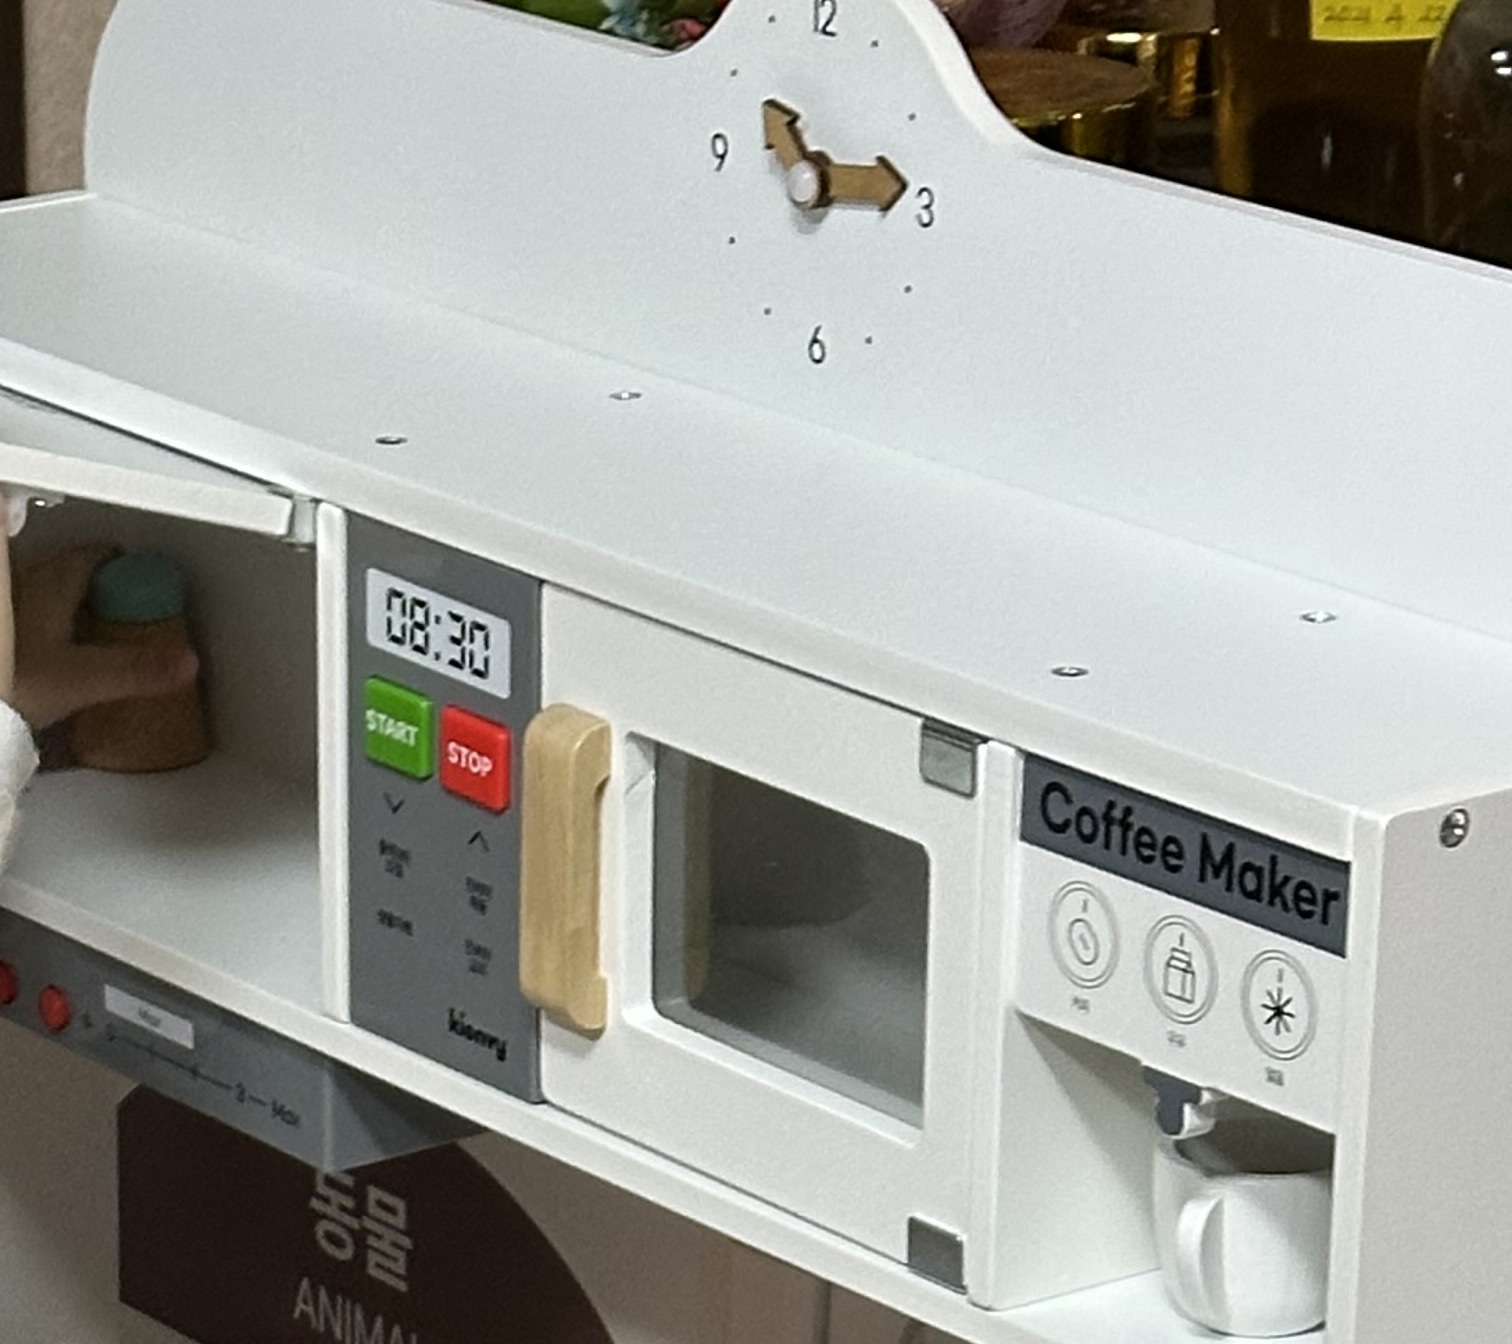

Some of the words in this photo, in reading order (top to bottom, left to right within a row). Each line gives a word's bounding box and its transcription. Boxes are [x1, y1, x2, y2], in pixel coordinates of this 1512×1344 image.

[813, 0, 837, 37] 12
[710, 132, 729, 172] 9
[916, 186, 935, 228] 3
[807, 324, 827, 365] 6
[386, 586, 490, 681] 08:30
[365, 708, 419, 747] START
[447, 741, 493, 778] STOP
[1040, 780, 1185, 874] Coffee
[1197, 832, 1342, 926] Maker
[308, 1166, 414, 1293] 동물
